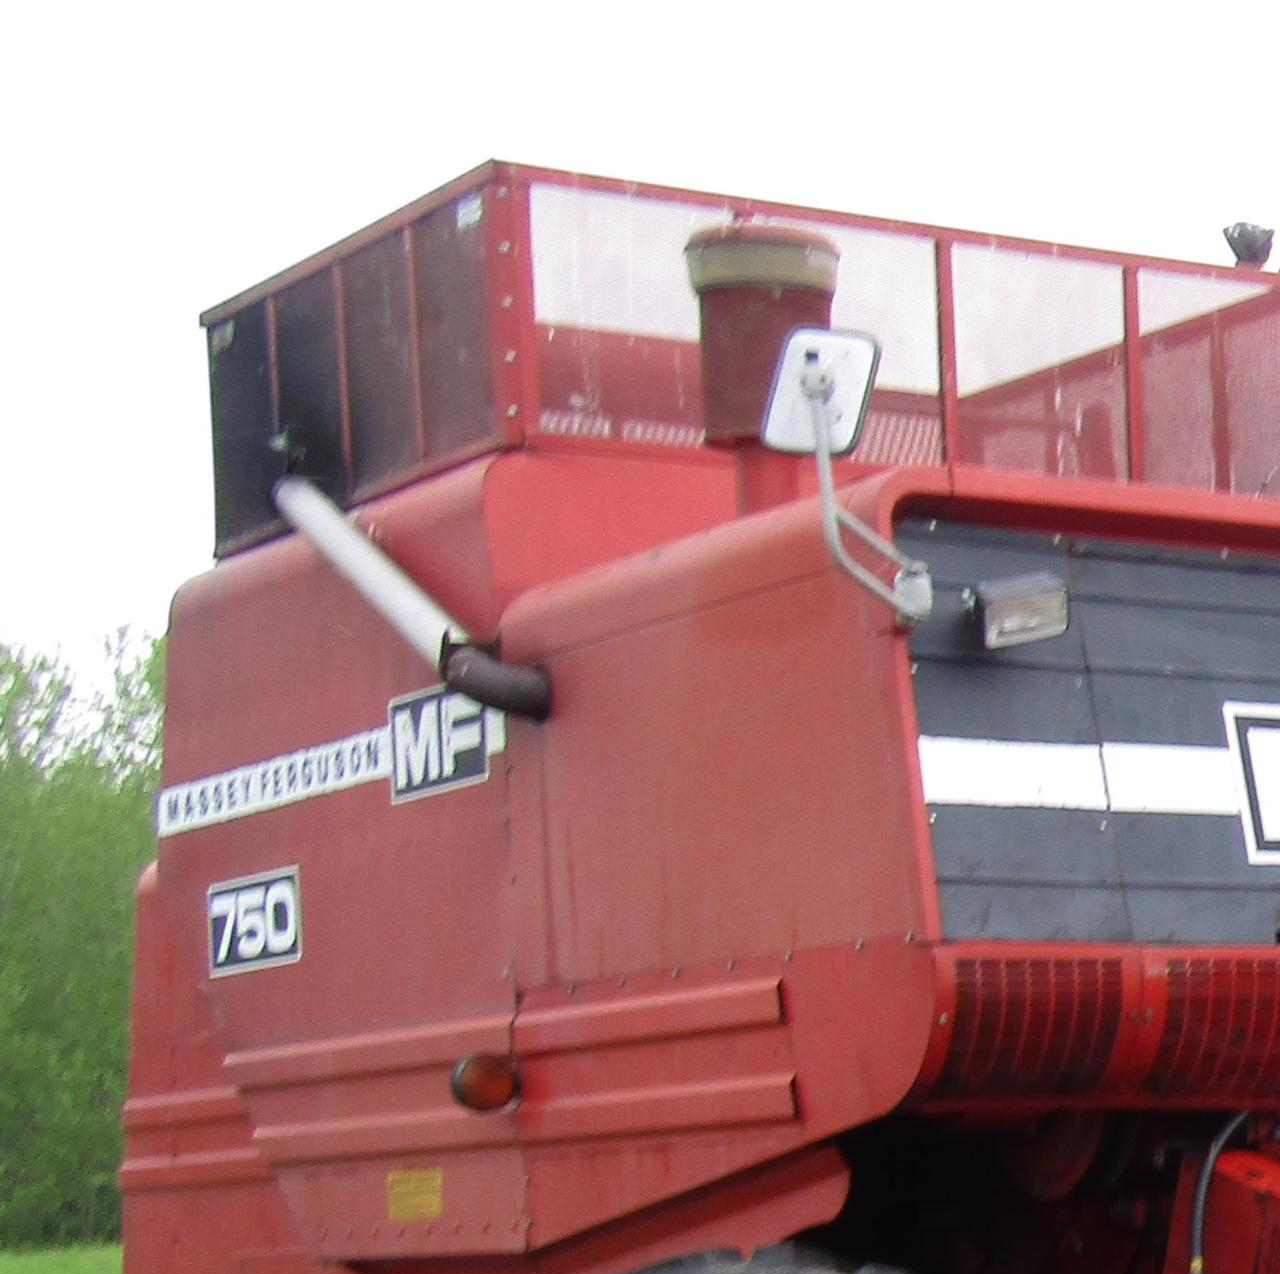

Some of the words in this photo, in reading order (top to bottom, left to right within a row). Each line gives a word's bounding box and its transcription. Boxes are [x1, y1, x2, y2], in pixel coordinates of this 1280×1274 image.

[167, 773, 252, 822] MASSEY
[259, 736, 379, 799] FERGUSON
[394, 692, 482, 790] MF
[210, 880, 296, 963] 750
